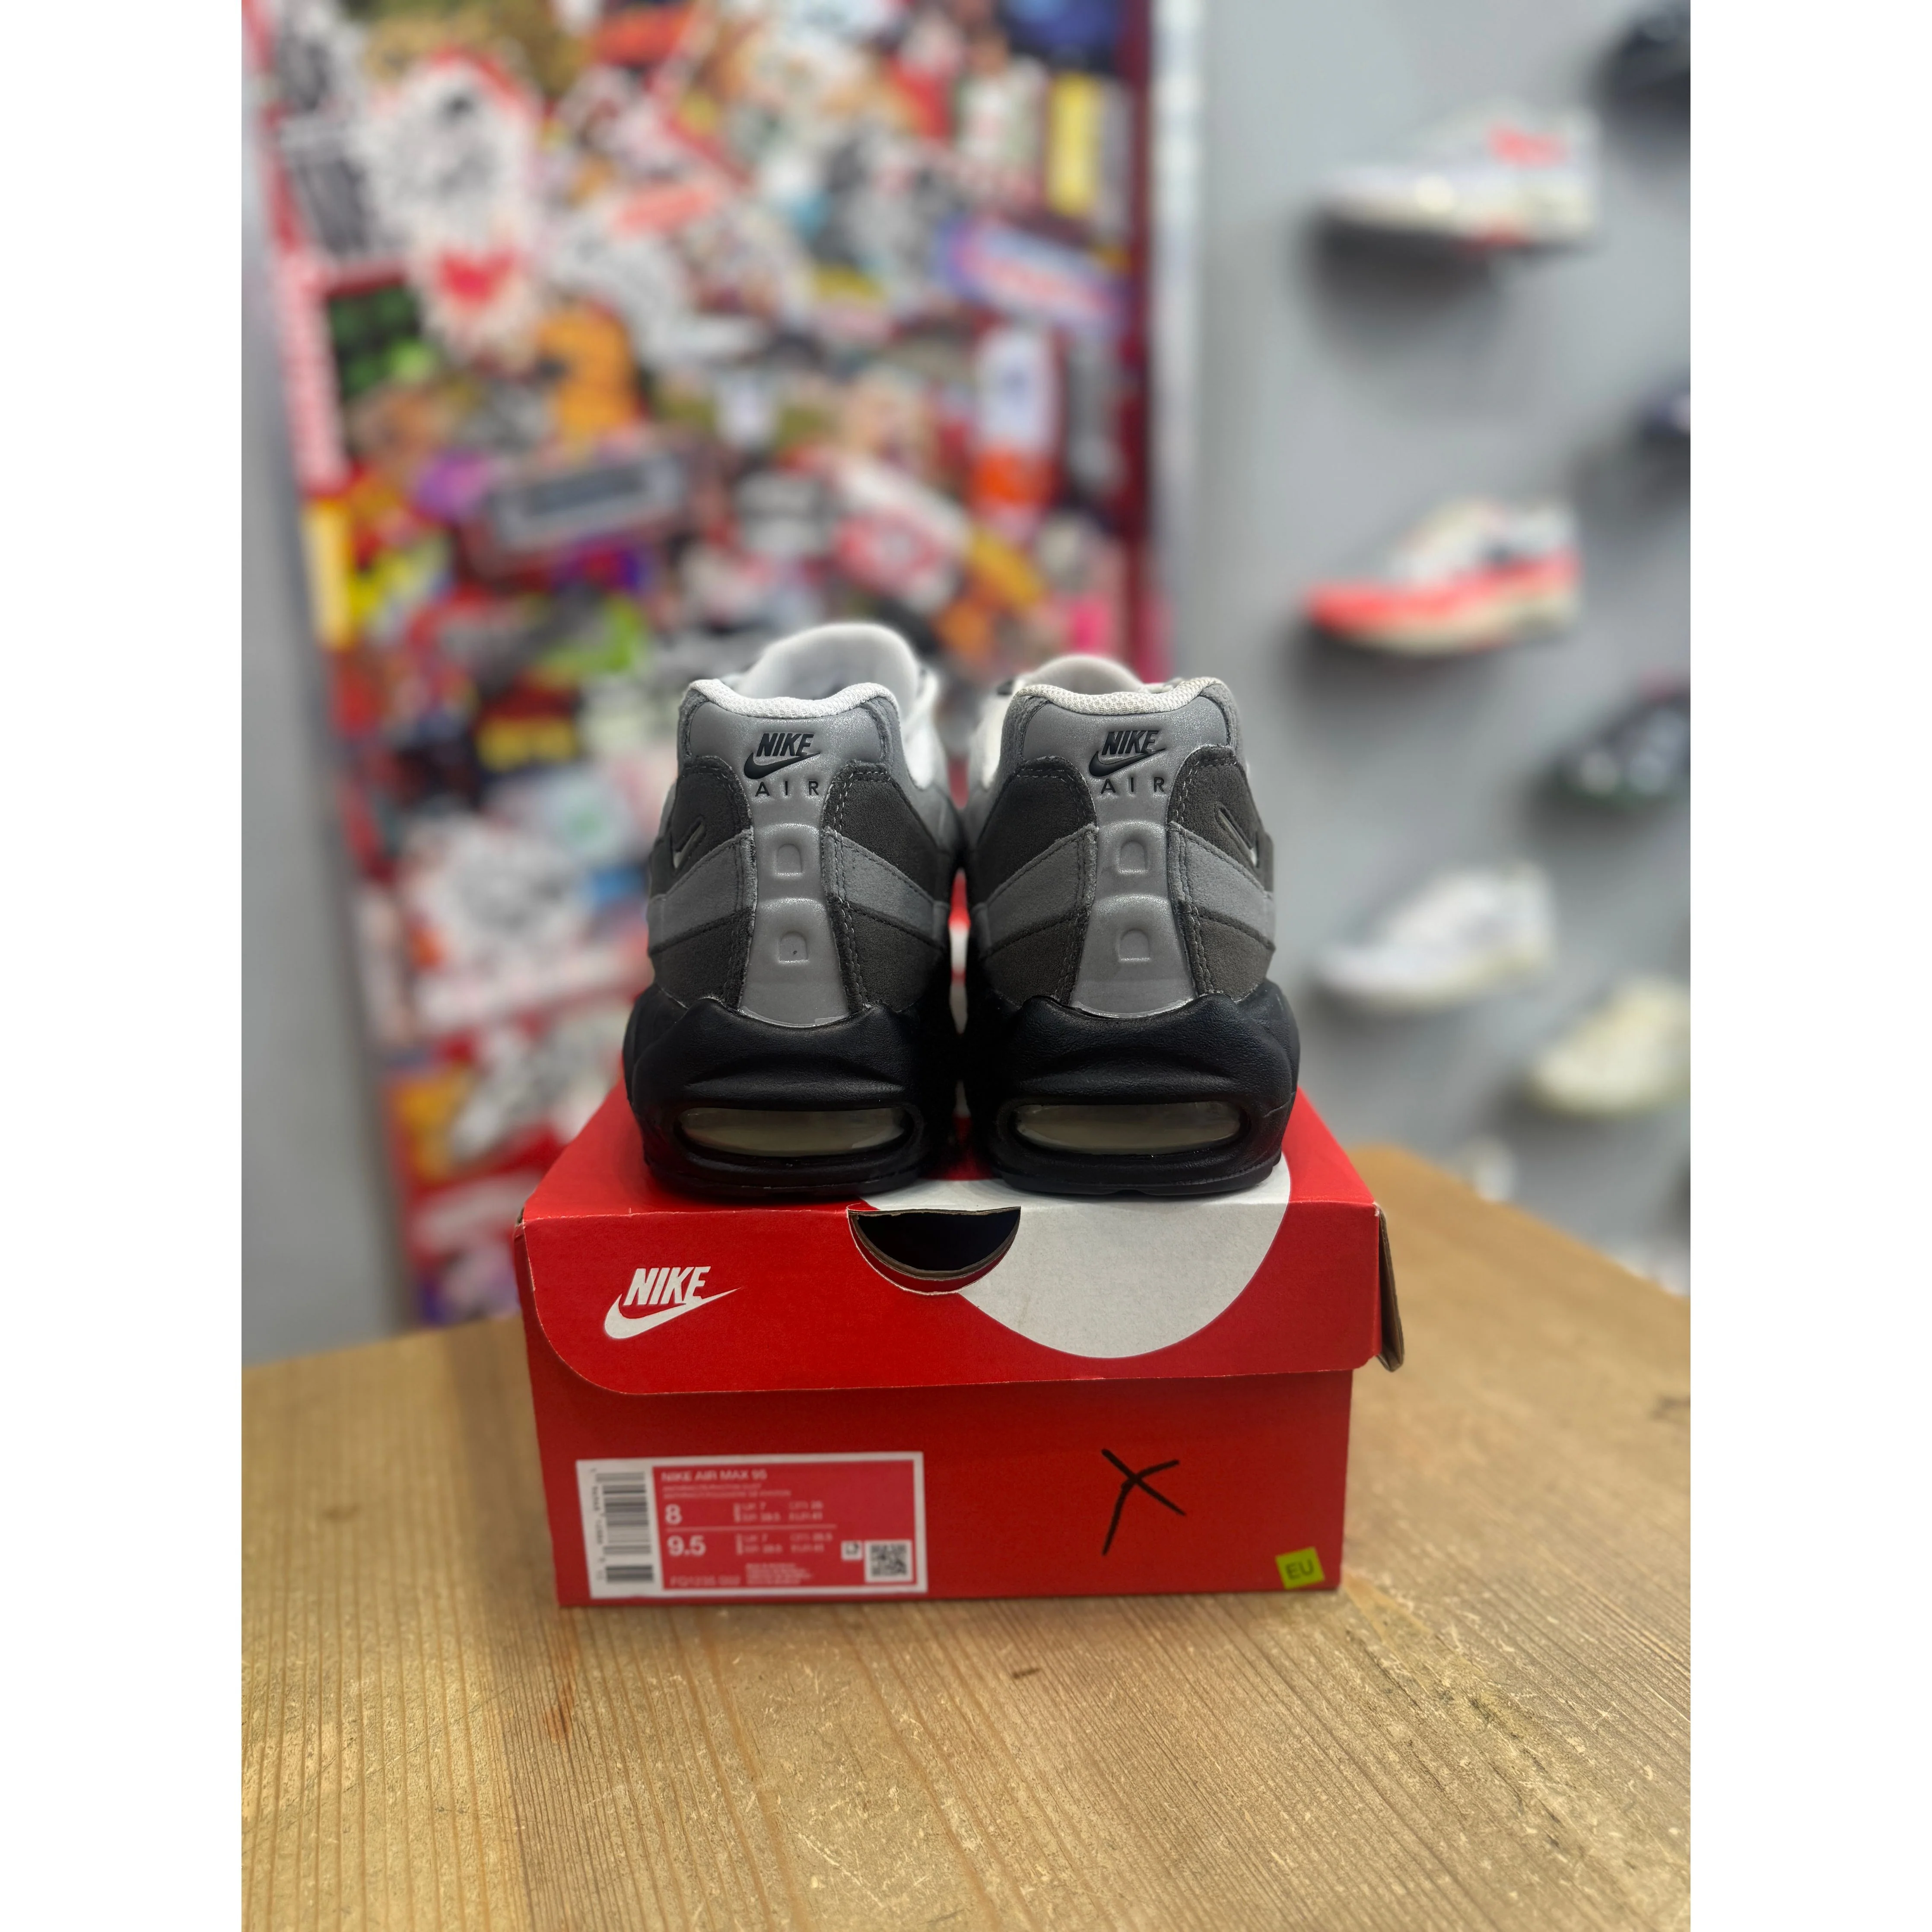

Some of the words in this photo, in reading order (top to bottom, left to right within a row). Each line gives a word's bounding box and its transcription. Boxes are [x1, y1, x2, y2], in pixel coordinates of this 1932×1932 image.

[756, 733, 814, 757] NIKE
[1102, 730, 1159, 755] NIKE
[755, 781, 819, 797] AIR
[1101, 777, 1164, 794] AIR
[623, 1266, 711, 1306] NIKE
[661, 1471, 691, 1482] NIKE
[695, 1470, 717, 1481] AIR
[720, 1469, 748, 1480] MAX
[752, 1468, 767, 1480] 95
[665, 1504, 683, 1524] 8
[667, 1535, 706, 1556] 9.5
[1285, 1559, 1315, 1579] EU
